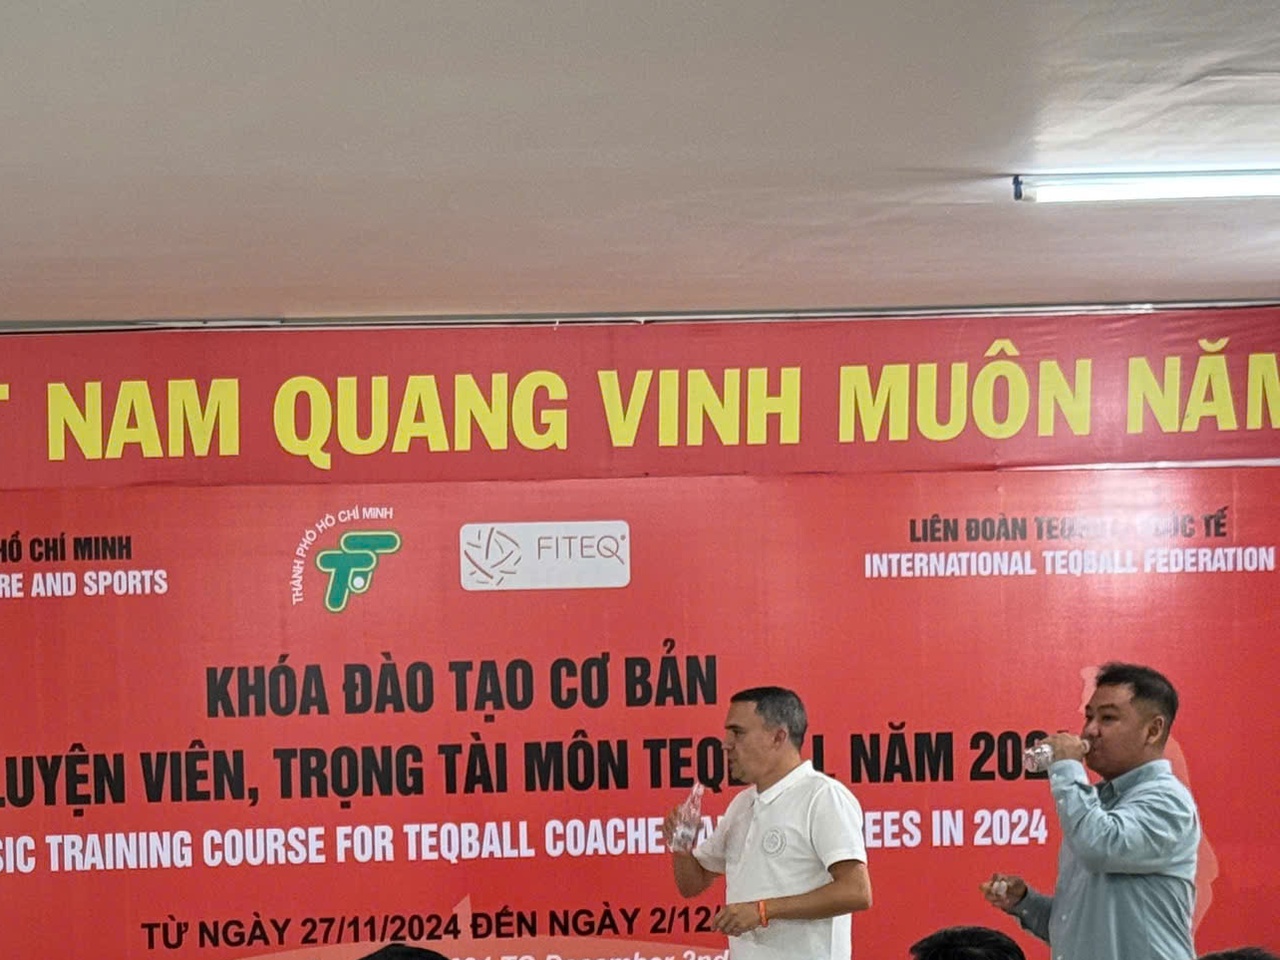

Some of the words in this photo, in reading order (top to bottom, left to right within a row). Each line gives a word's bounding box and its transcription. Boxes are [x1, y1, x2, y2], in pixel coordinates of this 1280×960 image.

[47, 378, 240, 461] NAM
[273, 370, 568, 470] QUANG
[597, 366, 802, 448] VINH
[838, 338, 1093, 443] MUÔN
[362, 506, 394, 520] MINH
[909, 514, 959, 544] LIÊN
[965, 512, 1028, 542] ĐOÀN
[1203, 505, 1229, 538] TẾ
[29, 532, 66, 562] CHÍ
[73, 535, 133, 561] MINH
[864, 550, 1036, 578] INTERNATIONAL
[1042, 548, 1138, 576] TEQBALL
[1144, 545, 1277, 574] FEDERATION
[31, 570, 77, 598] AND
[83, 569, 169, 596] SPORTS
[205, 653, 329, 718] KHÓA
[342, 652, 434, 715] ĐÀO
[449, 658, 534, 723] TẠO
[549, 651, 610, 708] CƠ
[624, 638, 718, 706] BẢN
[139, 740, 259, 807] VIÊN,
[273, 746, 424, 809] TRỌNG
[437, 732, 508, 795] TÀI
[524, 730, 629, 792] MÔN
[643, 735, 835, 793] TEQL
[850, 721, 953, 784] NĂM
[969, 730, 1068, 781] 202
[45, 830, 192, 872] TRAINING
[202, 826, 326, 867] COURSE
[336, 825, 395, 863] FOR
[403, 820, 536, 864] TEQBALL
[544, 816, 675, 857] COACHE
[931, 808, 964, 847] IN
[973, 807, 1049, 846] 2024
[141, 914, 190, 950] TỪ
[198, 911, 292, 948] NGÀY
[300, 908, 461, 945] 27/11/2024
[469, 904, 538, 940] ĐẾN
[548, 900, 642, 937] NGÀY
